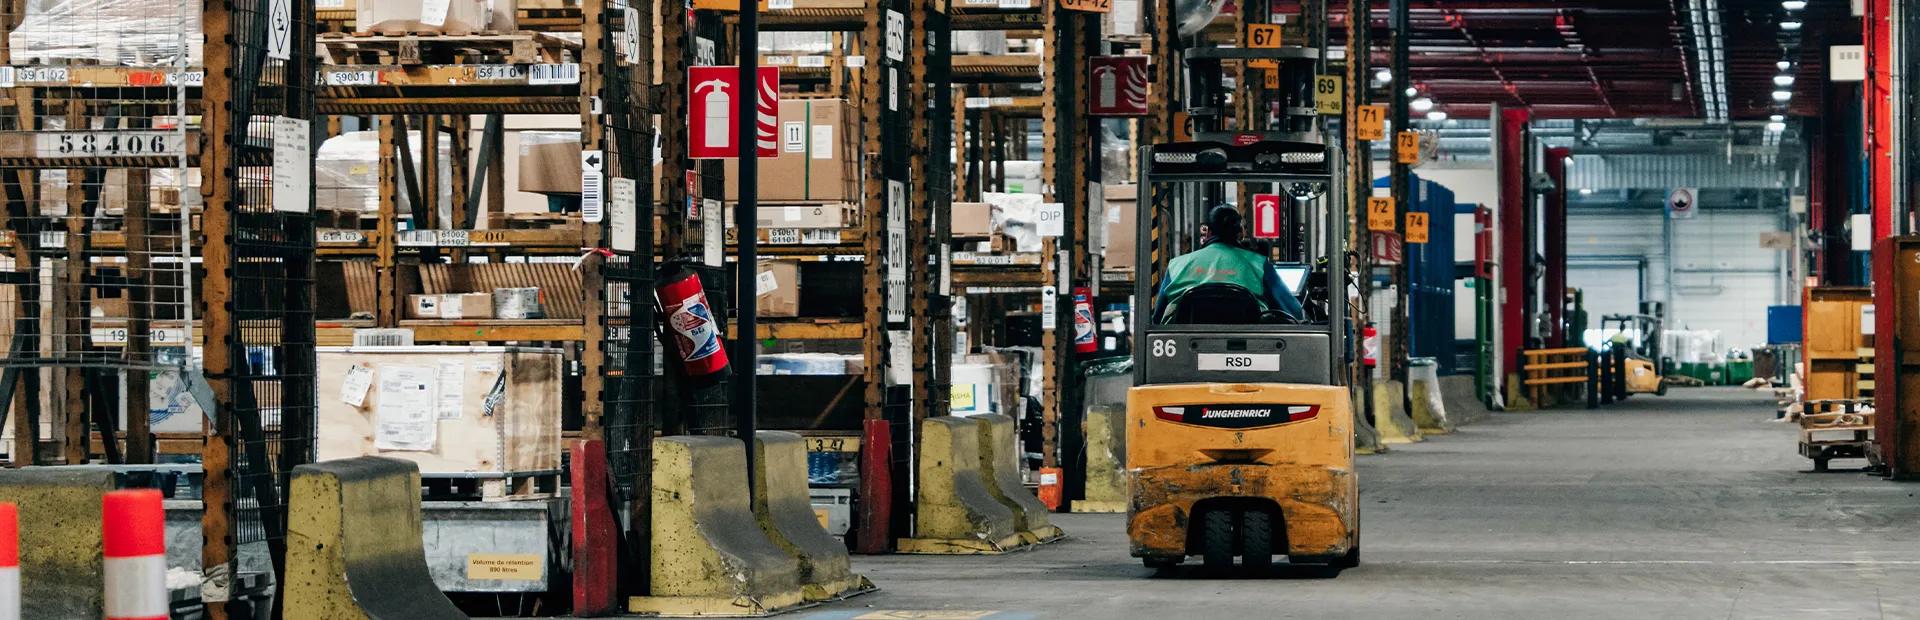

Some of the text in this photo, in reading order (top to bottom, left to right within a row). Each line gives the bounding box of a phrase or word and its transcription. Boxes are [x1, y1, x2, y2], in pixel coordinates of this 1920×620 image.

[1254, 28, 1274, 46] 67
[172, 73, 201, 82] 5002
[335, 73, 365, 82] 59001
[1318, 79, 1335, 94] 69
[1362, 108, 1377, 123] 71
[59, 135, 165, 154] 58406
[1400, 134, 1414, 148] 73
[1372, 199, 1388, 214] 72
[1040, 210, 1061, 222] DIP
[1408, 214, 1423, 228] 74
[1152, 339, 1177, 357] 86
[1225, 357, 1253, 368] RSD
[1201, 407, 1272, 419] JUNGHEINRICH
